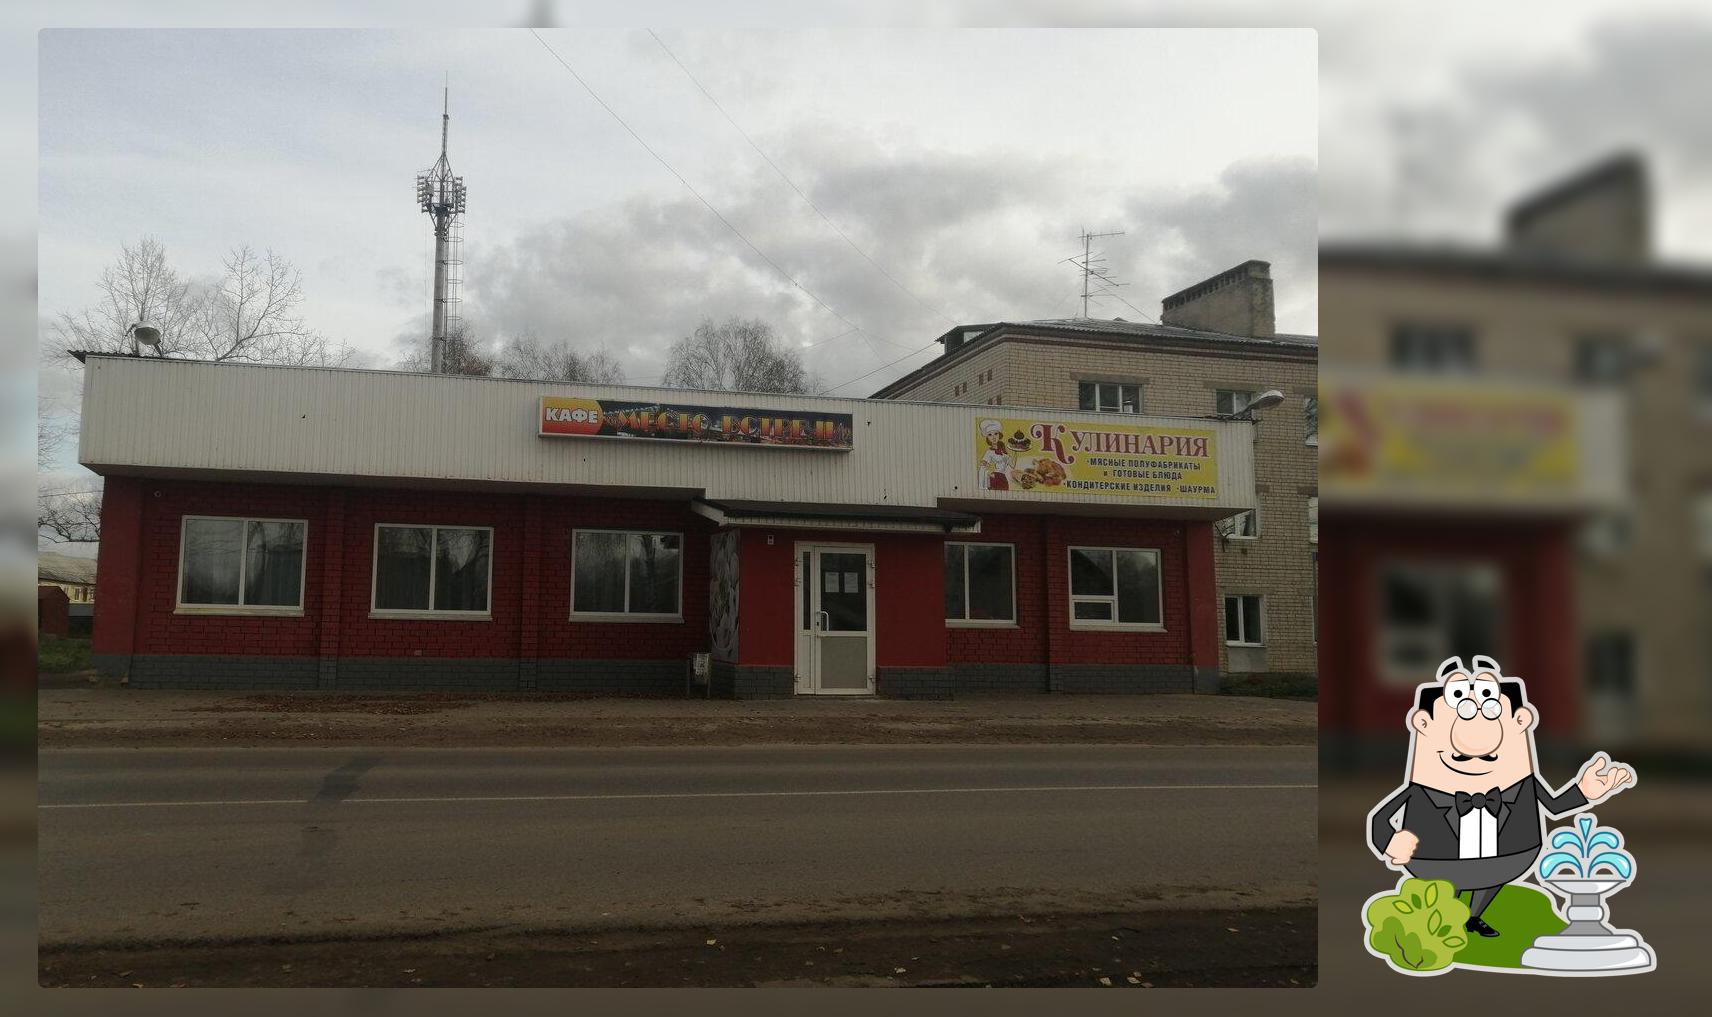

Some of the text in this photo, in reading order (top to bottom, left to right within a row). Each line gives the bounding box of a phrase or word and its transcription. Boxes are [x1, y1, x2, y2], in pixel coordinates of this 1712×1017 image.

[545, 407, 599, 424] КАФЕ
[1030, 423, 1210, 465] КУЛИНАРИЯ
[1128, 460, 1201, 471] ПОЛУФАБРИКАТЫ
[1112, 469, 1151, 479] ГОТОВЫЕ
[1152, 471, 1183, 481] БЛЮДА
[1066, 480, 1131, 491] КОНДИТЕРСКИЕ
[1133, 483, 1172, 493] ИЗДЕЛИЯ
